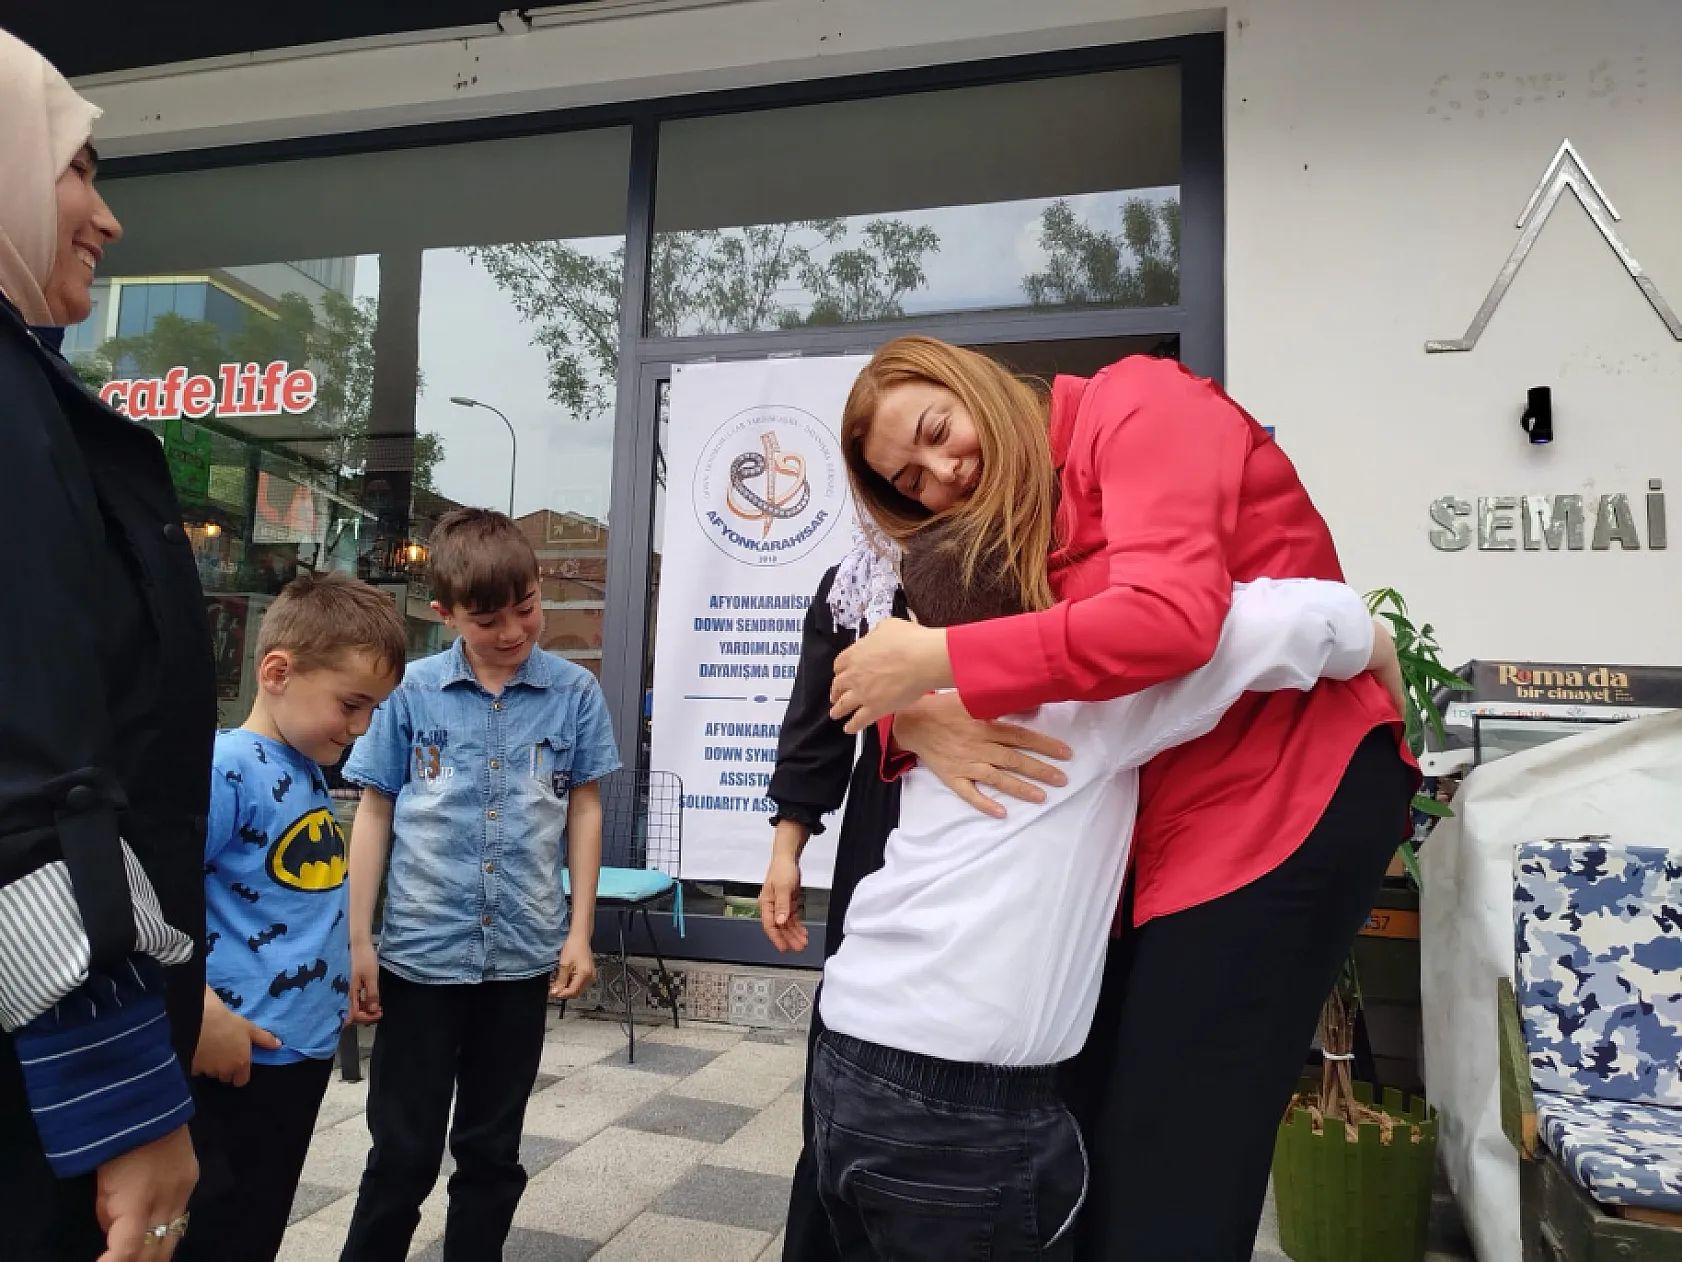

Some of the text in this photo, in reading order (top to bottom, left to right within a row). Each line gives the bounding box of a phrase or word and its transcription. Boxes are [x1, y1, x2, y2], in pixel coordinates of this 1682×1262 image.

[1429, 478, 1667, 551] SEMAİ
[693, 617, 804, 633] DOWN SENDROML
[699, 663, 797, 680] DAYANIŞMA DER
[704, 746, 742, 760] DOWN
